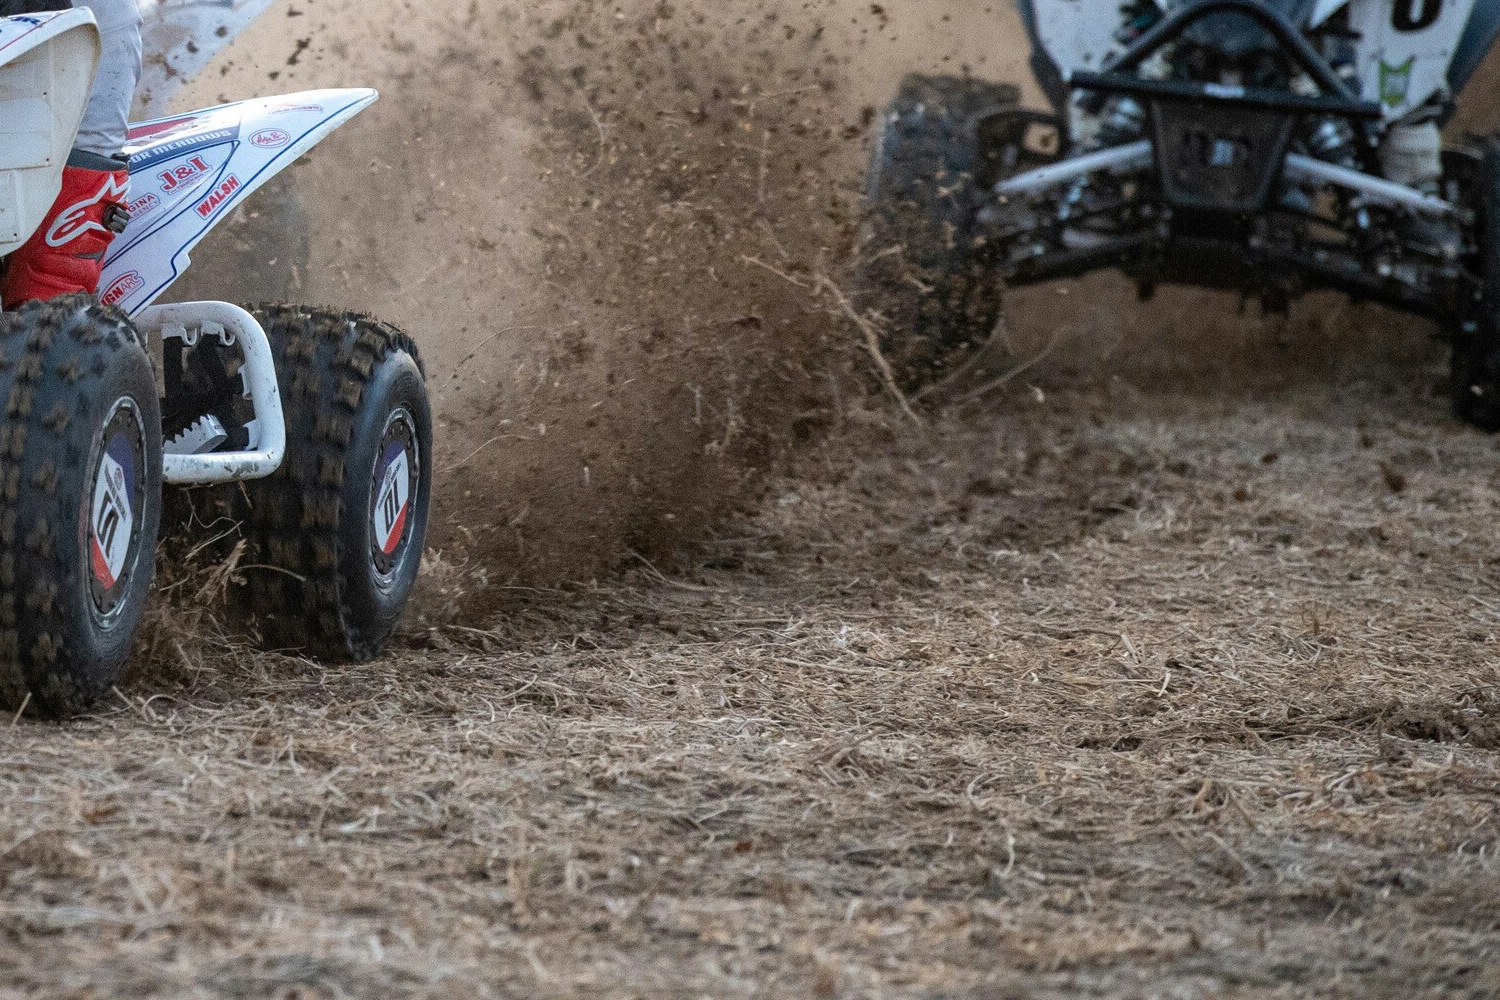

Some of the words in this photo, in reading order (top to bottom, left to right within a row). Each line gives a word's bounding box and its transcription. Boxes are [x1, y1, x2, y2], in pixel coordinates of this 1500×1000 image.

[153, 130, 232, 156] MEADOWS
[159, 156, 210, 192] J&I
[128, 193, 156, 213] GINA
[196, 175, 241, 218] WALSH
[101, 272, 142, 306] IGNARC
